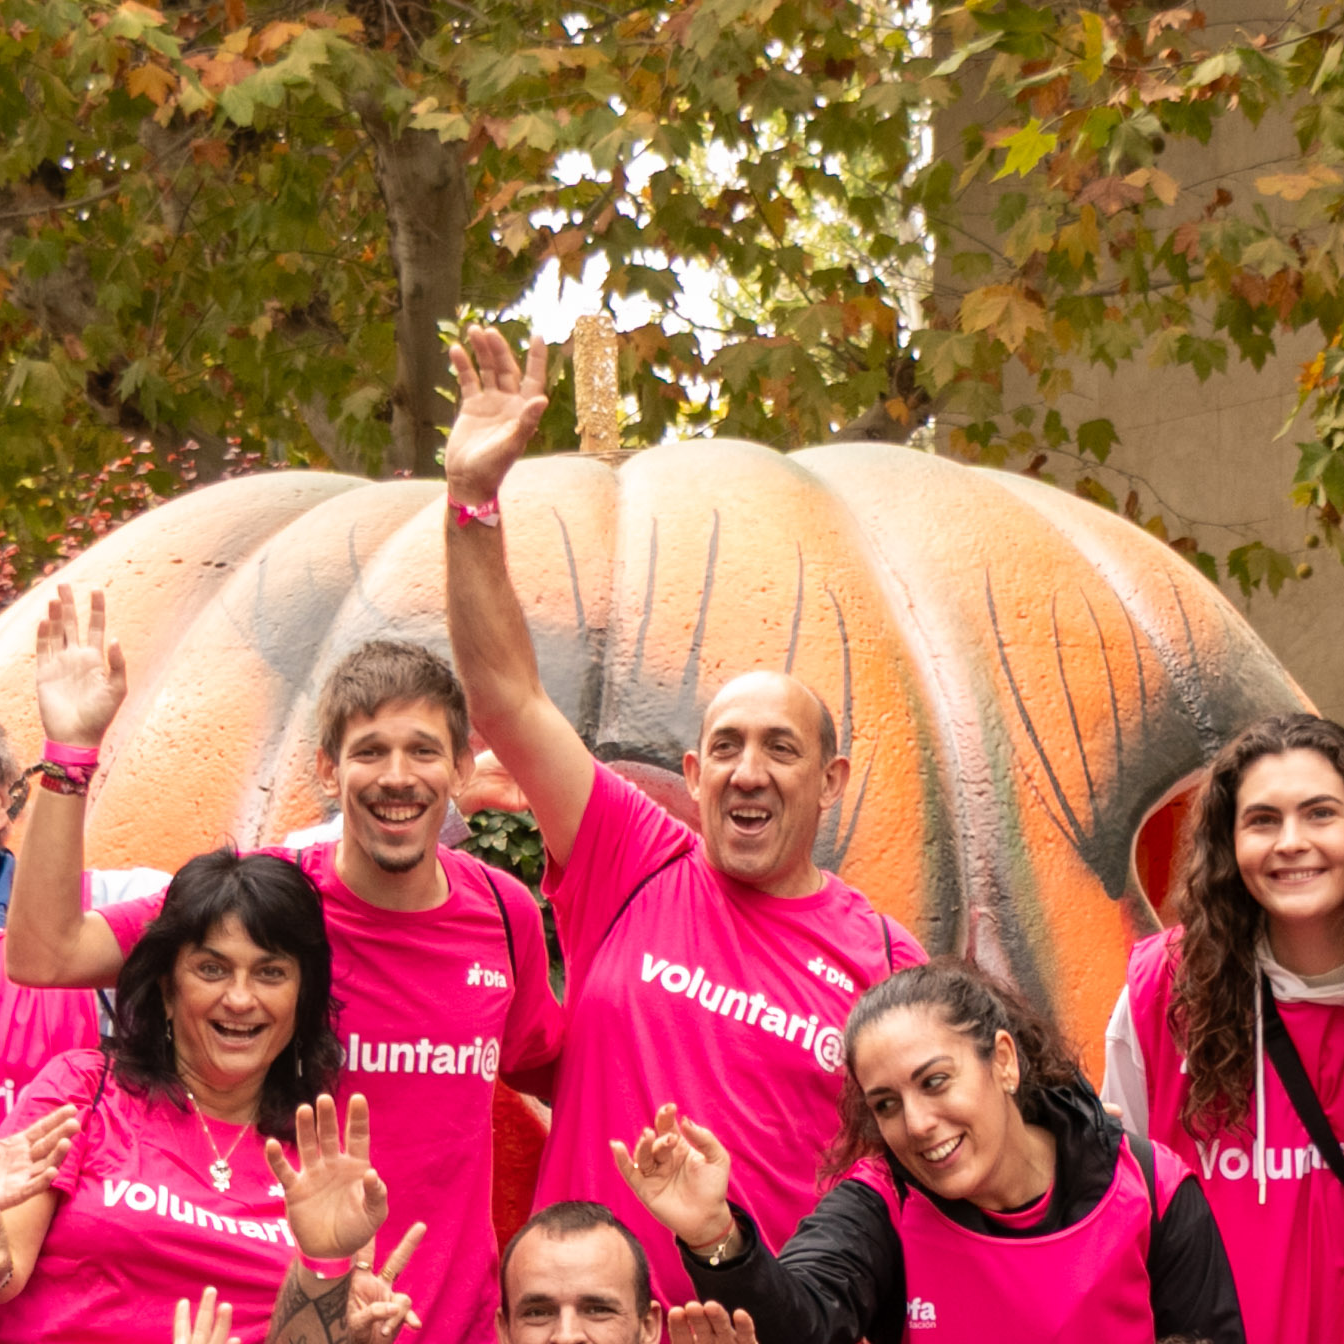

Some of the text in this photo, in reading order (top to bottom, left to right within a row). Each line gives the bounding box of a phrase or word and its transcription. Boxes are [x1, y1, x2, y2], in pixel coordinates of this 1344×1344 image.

[484, 968, 508, 988] Dfa
[825, 966, 855, 994] Dfa
[340, 1032, 501, 1083] luntari@
[103, 1179, 296, 1248] voluntari
[907, 1296, 937, 1321] fa
